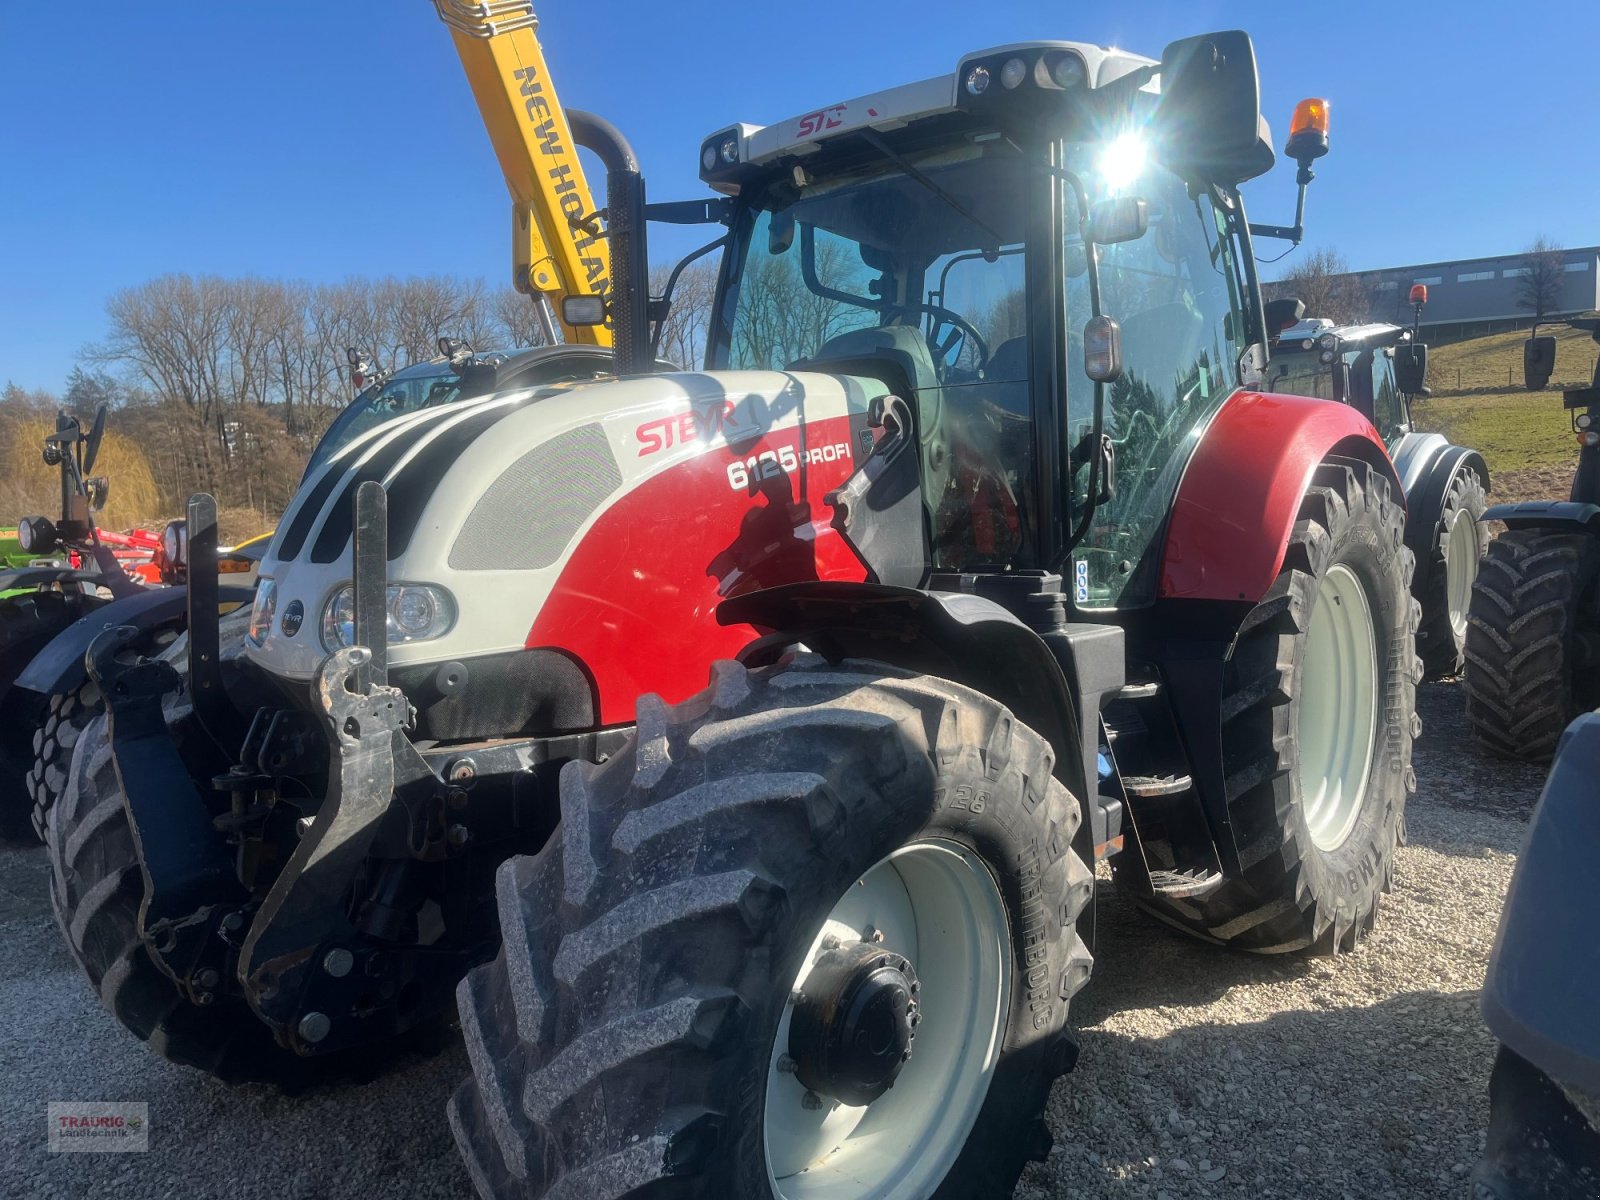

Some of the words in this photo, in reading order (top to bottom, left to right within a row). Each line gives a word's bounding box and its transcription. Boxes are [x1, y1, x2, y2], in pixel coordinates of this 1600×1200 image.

[513, 66, 564, 155] NEW
[549, 164, 614, 303] HOLLAN
[636, 400, 738, 458] STEYR
[726, 445, 798, 491] 6125
[798, 443, 851, 467] PROFI
[949, 784, 991, 815] 28
[1017, 836, 1053, 1031] TRELLEBORG
